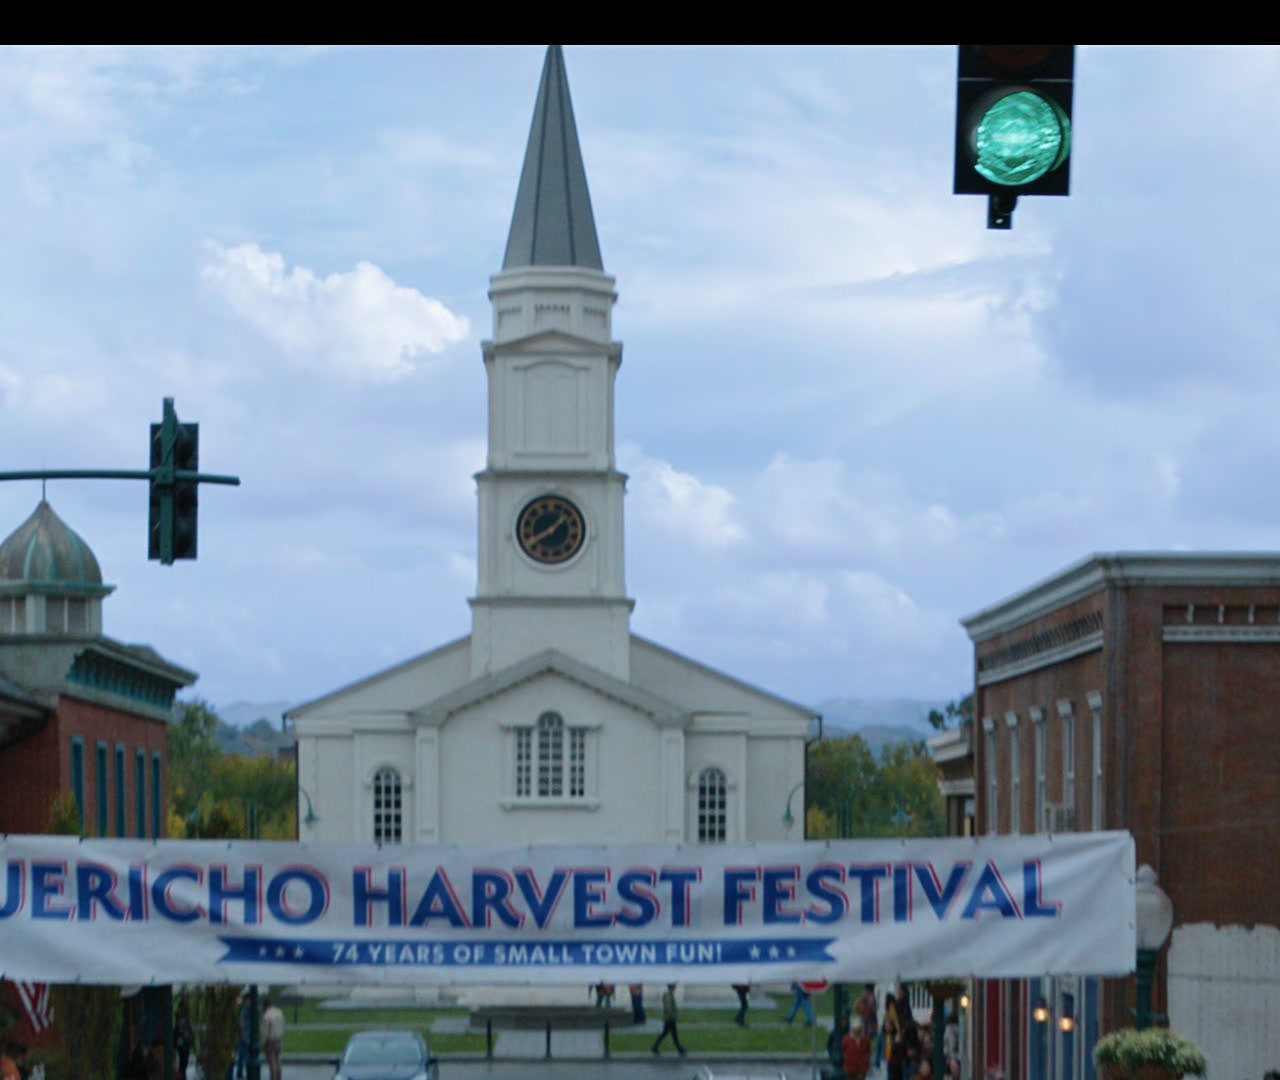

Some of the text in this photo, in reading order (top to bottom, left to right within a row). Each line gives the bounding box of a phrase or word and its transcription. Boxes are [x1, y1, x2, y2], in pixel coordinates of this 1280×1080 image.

[352, 865, 703, 930] HARVEST
[723, 858, 1062, 926] FESTIVAL
[332, 943, 723, 964] 74 YEARS OF SMALL TOWN FUN!
